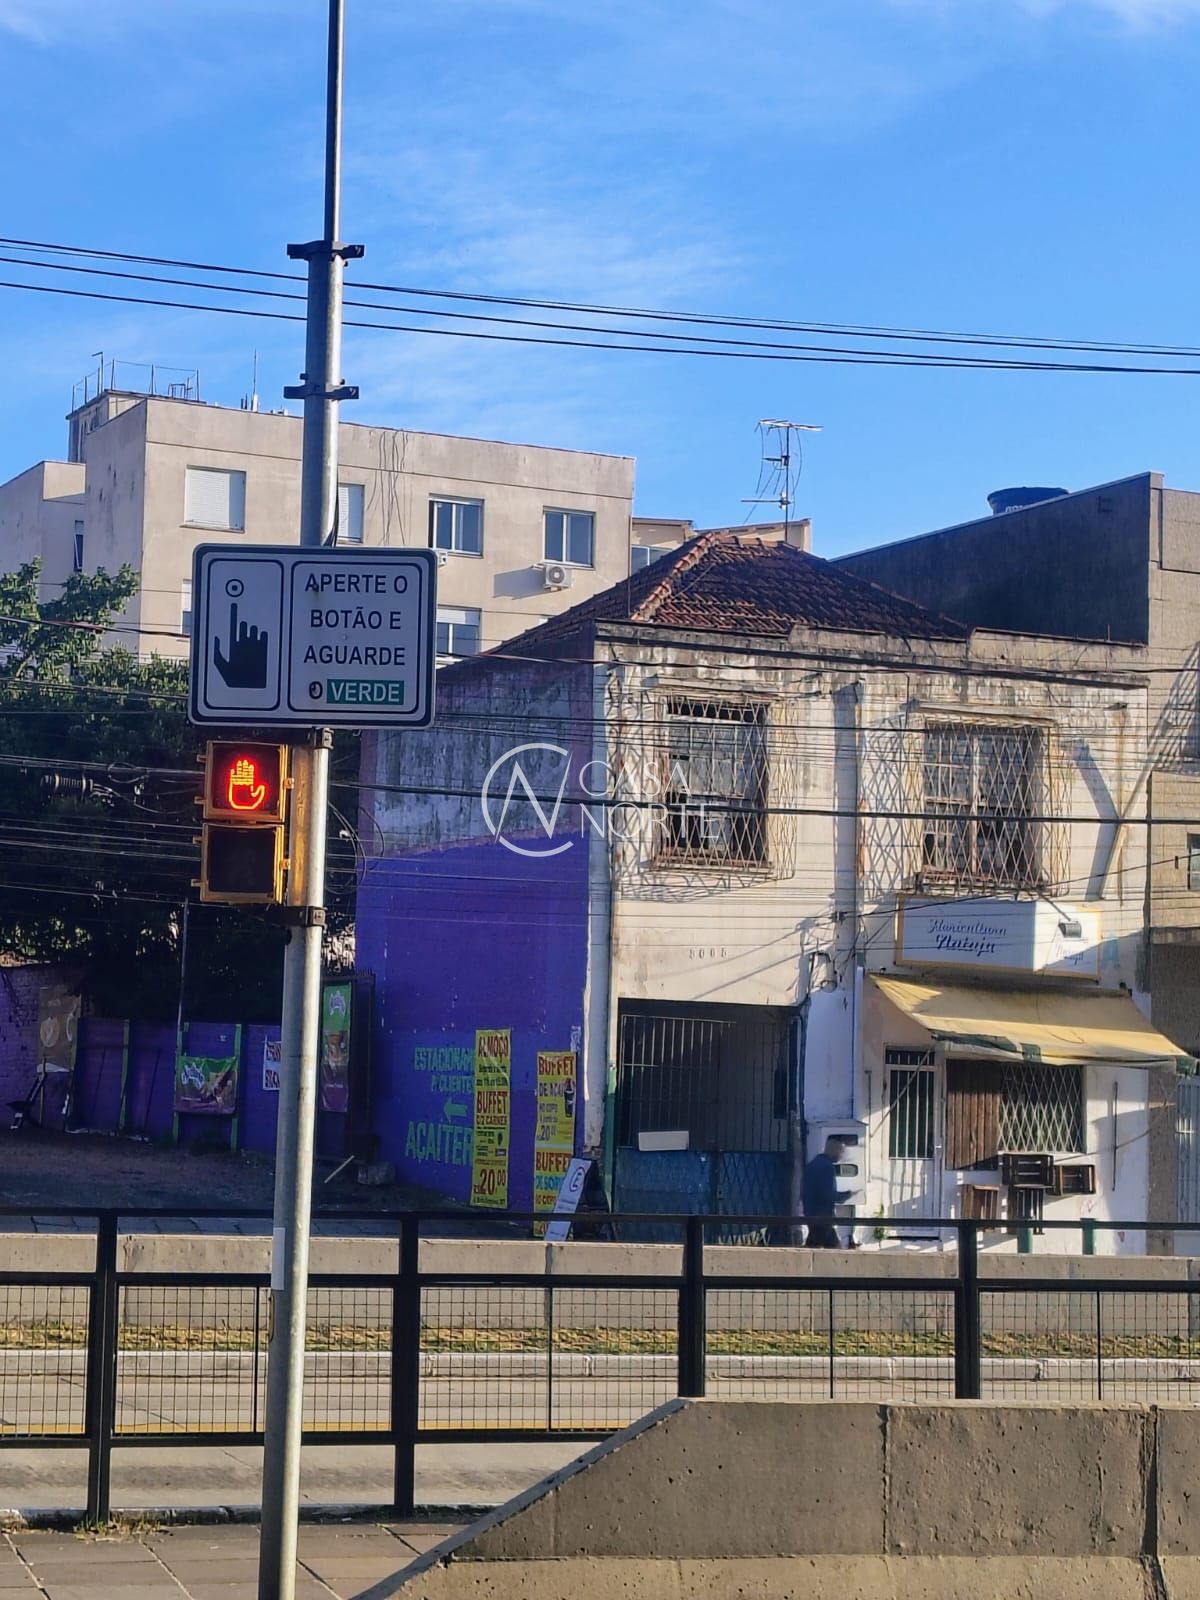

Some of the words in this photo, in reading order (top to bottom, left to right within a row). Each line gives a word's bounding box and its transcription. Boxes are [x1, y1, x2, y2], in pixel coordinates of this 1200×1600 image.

[304, 573, 387, 594] APERTE
[393, 575, 408, 594] O
[310, 606, 382, 630] BOTÃO
[389, 611, 401, 630] E
[303, 645, 406, 666] AGUARDE
[308, 680, 323, 700] O
[331, 681, 400, 702] VERDE
[538, 1055, 575, 1076] BUFFET
[477, 1091, 508, 1114] BUFFET
